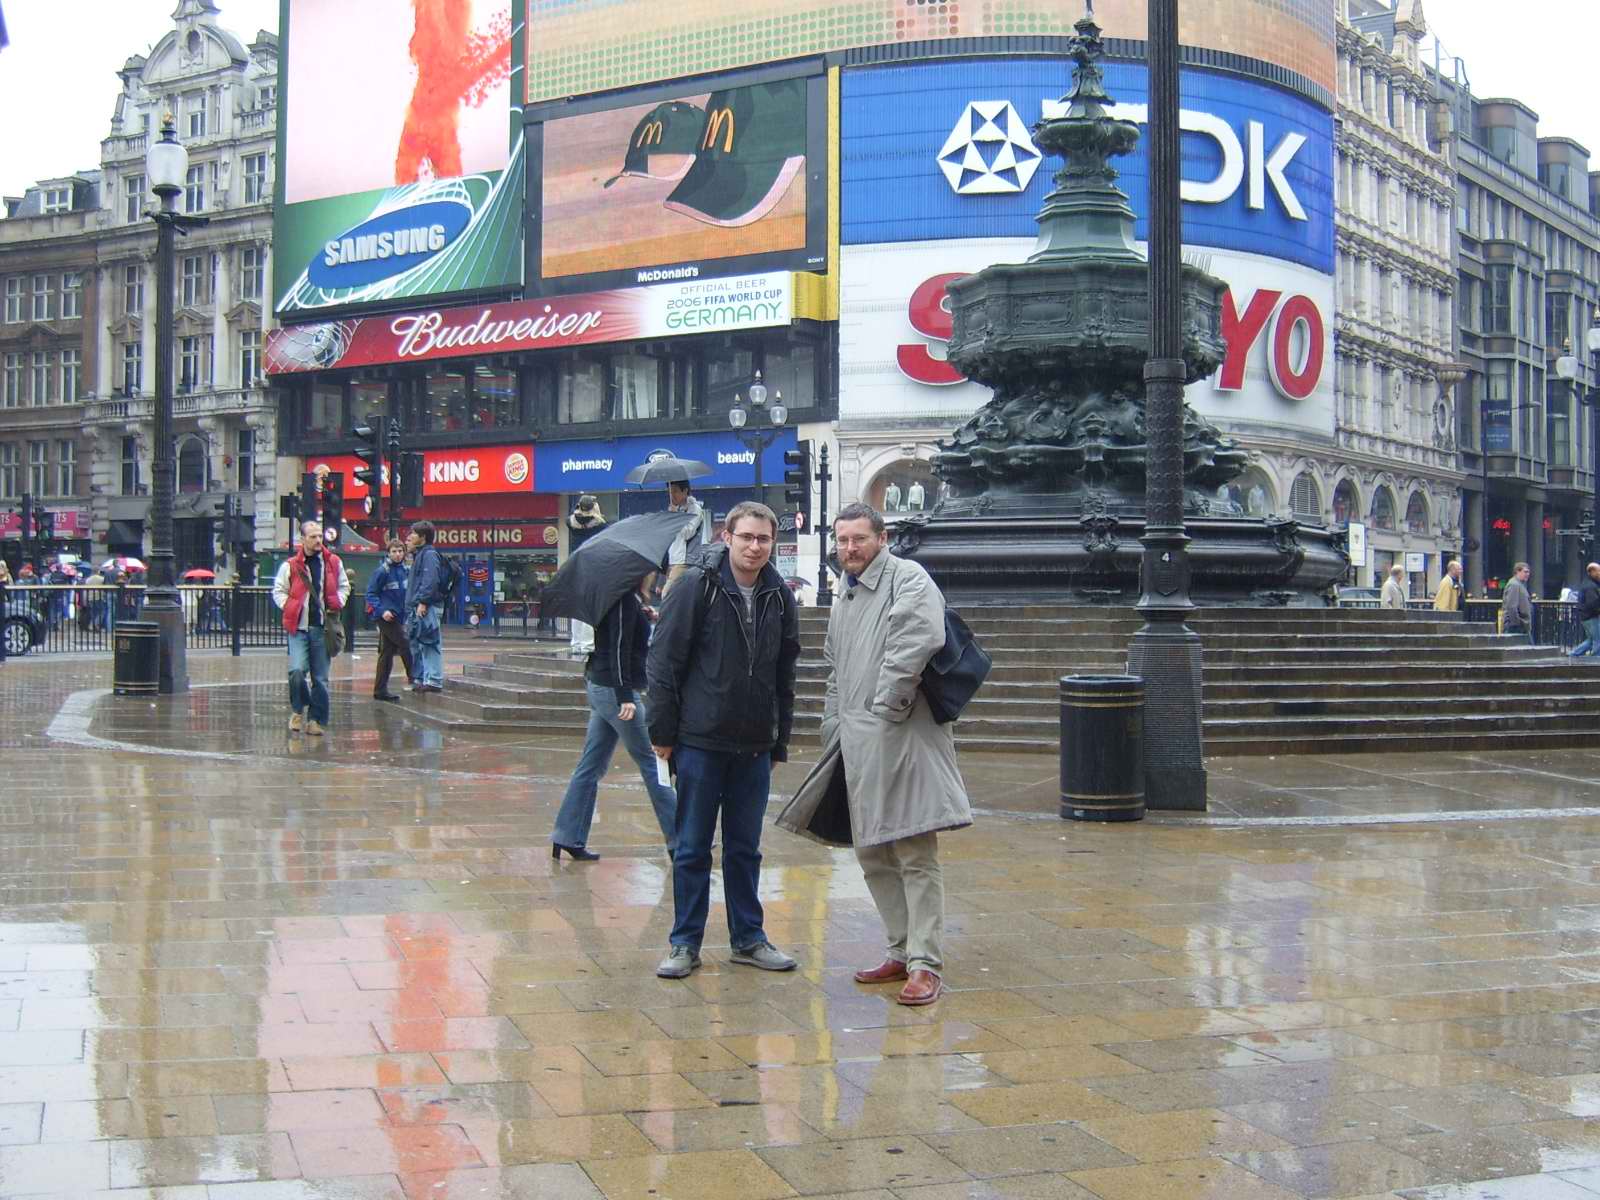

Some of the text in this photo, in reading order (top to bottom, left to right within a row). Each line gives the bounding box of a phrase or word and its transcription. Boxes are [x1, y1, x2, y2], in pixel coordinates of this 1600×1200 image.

[324, 223, 446, 267] SAMSUNG
[637, 265, 699, 282] McDonald's
[680, 278, 767, 295] OFFICIAL BEER
[667, 288, 783, 310] 2006 FIFA WORLD CUP
[665, 301, 783, 329] GERMANY
[390, 304, 602, 358] Budweiser
[561, 458, 613, 474] pharmacy
[717, 450, 756, 465] beauty
[429, 459, 480, 483] KING
[482, 528, 522, 543] KING
